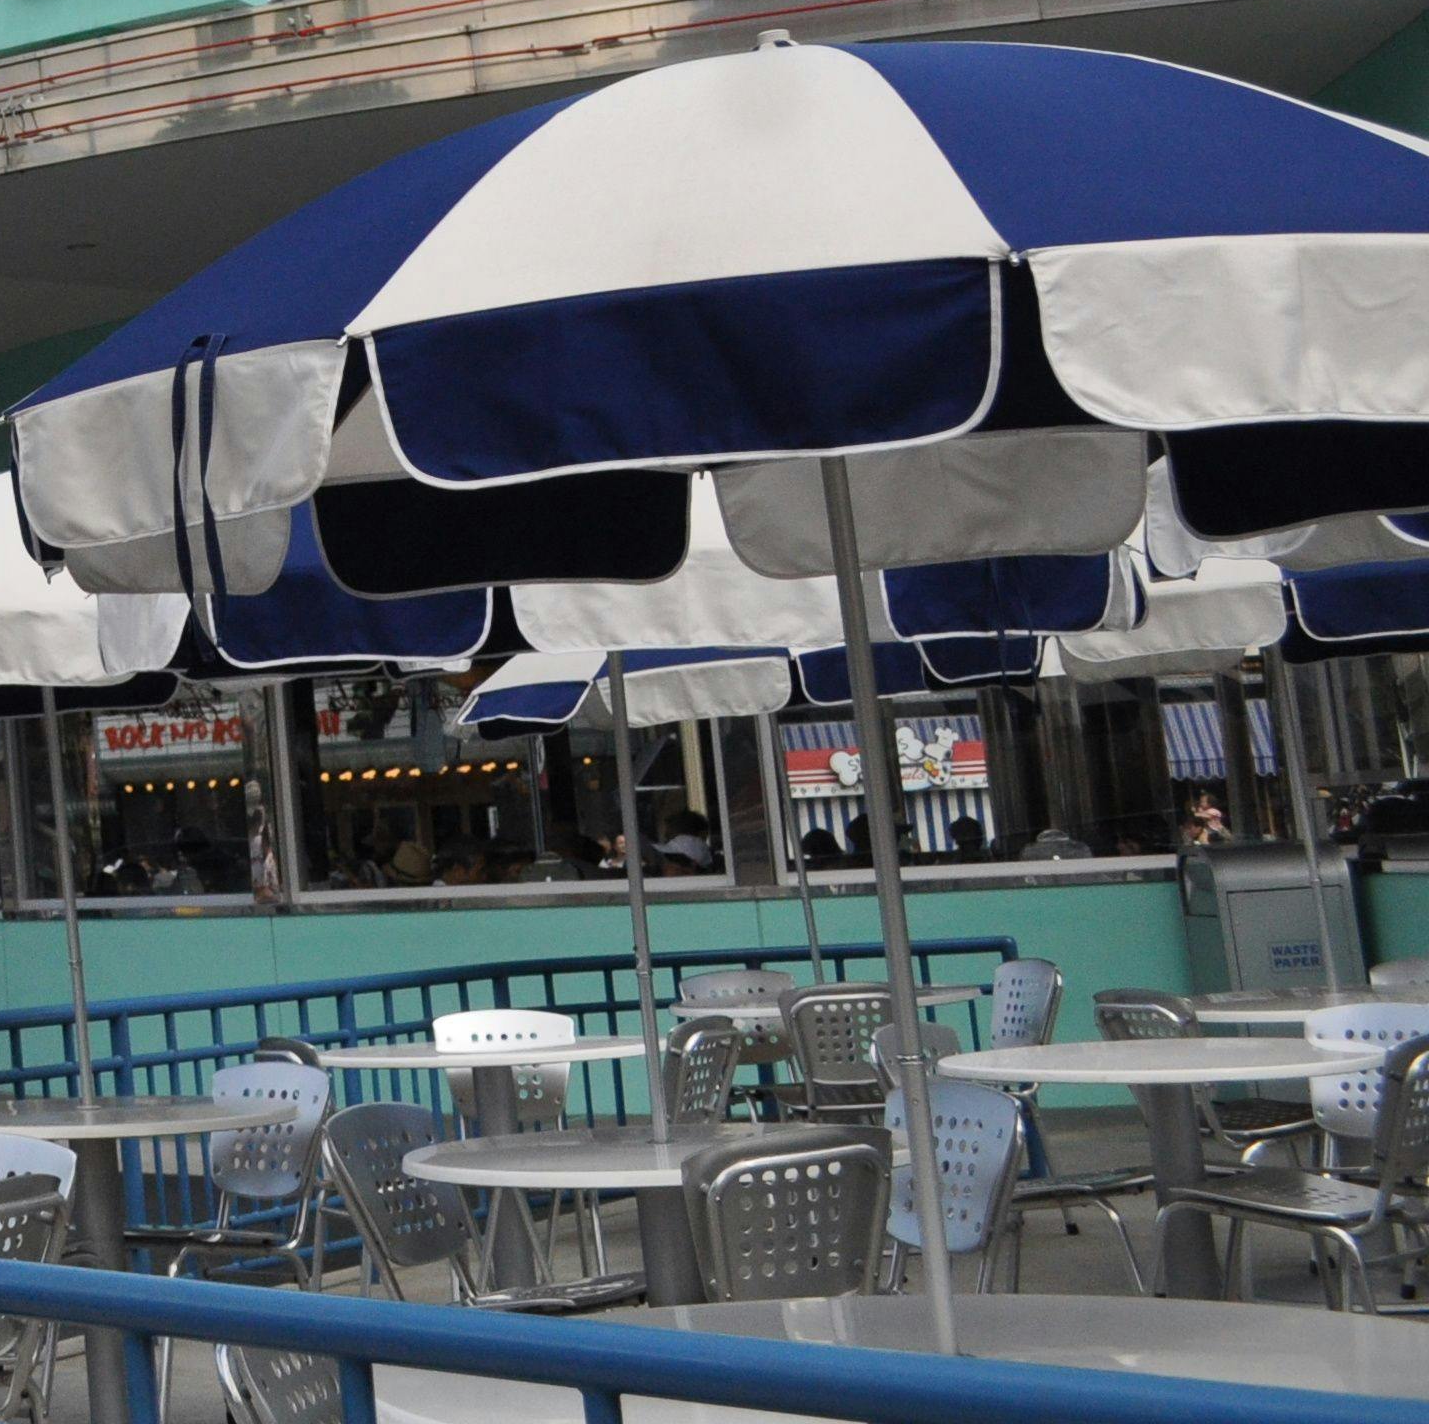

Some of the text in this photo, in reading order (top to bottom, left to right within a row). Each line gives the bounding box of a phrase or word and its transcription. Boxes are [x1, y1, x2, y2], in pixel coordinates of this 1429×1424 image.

[105, 722, 165, 751] ROCK
[1272, 944, 1319, 956] WASTE
[1274, 957, 1321, 968] PAPER
